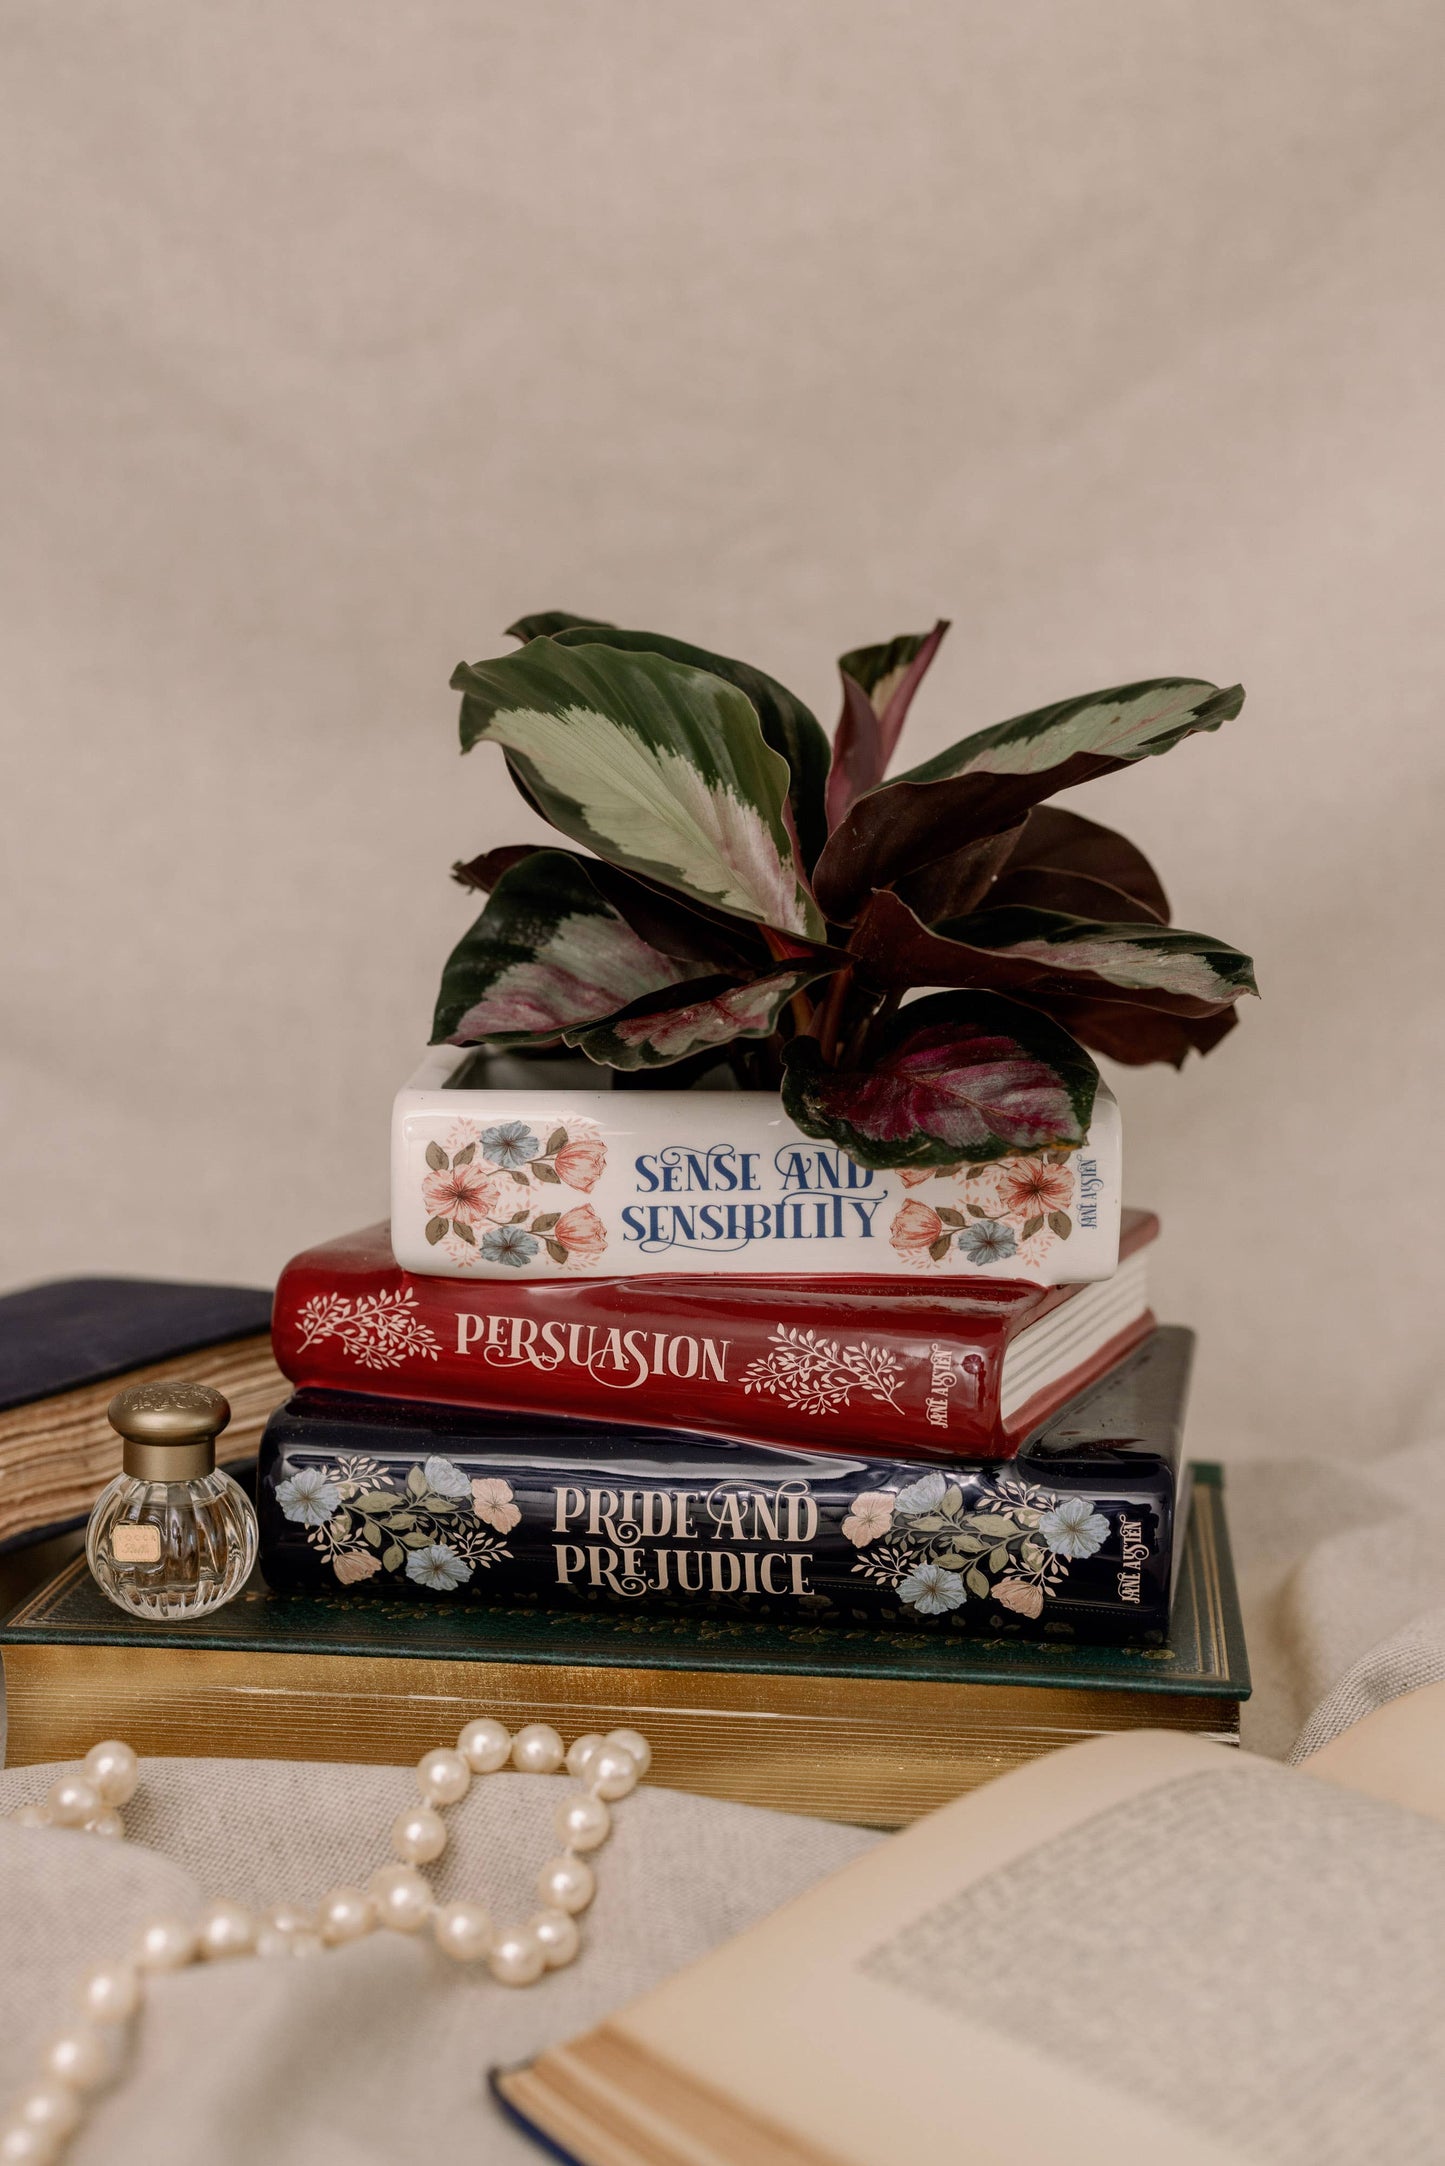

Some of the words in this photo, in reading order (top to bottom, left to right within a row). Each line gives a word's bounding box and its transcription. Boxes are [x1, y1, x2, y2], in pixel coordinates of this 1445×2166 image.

[635, 1143, 761, 1193] SENSE
[774, 1143, 875, 1191] AND
[1076, 1153, 1104, 1200] AUSTEN
[621, 1190, 889, 1254] SENSIBILITY
[1076, 1203, 1098, 1230] JANE
[454, 1312, 732, 1390] PERSUASION
[930, 1343, 957, 1397] AUSTEN
[925, 1397, 949, 1429] JANE
[551, 1486, 699, 1548] PRIDE
[706, 1480, 819, 1543] AND
[1119, 1514, 1150, 1571] AUSTEN
[551, 1543, 816, 1598] PREJUDICE
[1116, 1572, 1141, 1604] JANE
